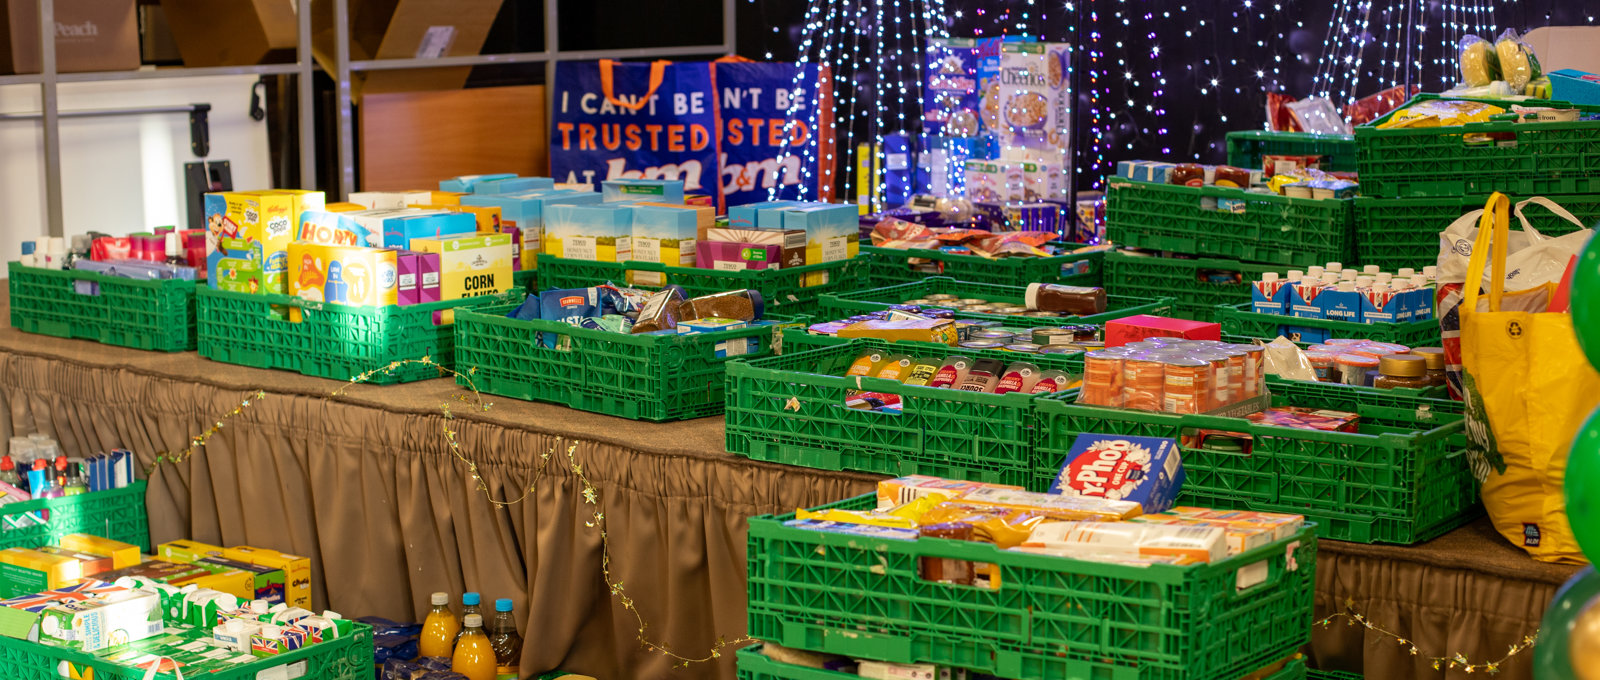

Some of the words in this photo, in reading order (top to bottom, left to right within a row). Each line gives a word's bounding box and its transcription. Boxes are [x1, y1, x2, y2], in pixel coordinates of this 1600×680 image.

[54, 20, 98, 37] Peach
[1001, 68, 1046, 87] Cheerios
[561, 91, 569, 113] I
[580, 92, 659, 116] CAN'T
[673, 92, 704, 115] BE
[723, 87, 762, 109] N'T
[775, 88, 806, 110] BE
[557, 122, 709, 152] TRUSTED
[727, 118, 808, 146] STED
[566, 170, 595, 184] AT
[269, 219, 288, 230] COCO
[464, 273, 495, 291] CORN
[1116, 461, 1129, 474] CUP
[1111, 472, 1123, 485] ONE
[1525, 537, 1539, 545] ALDI
